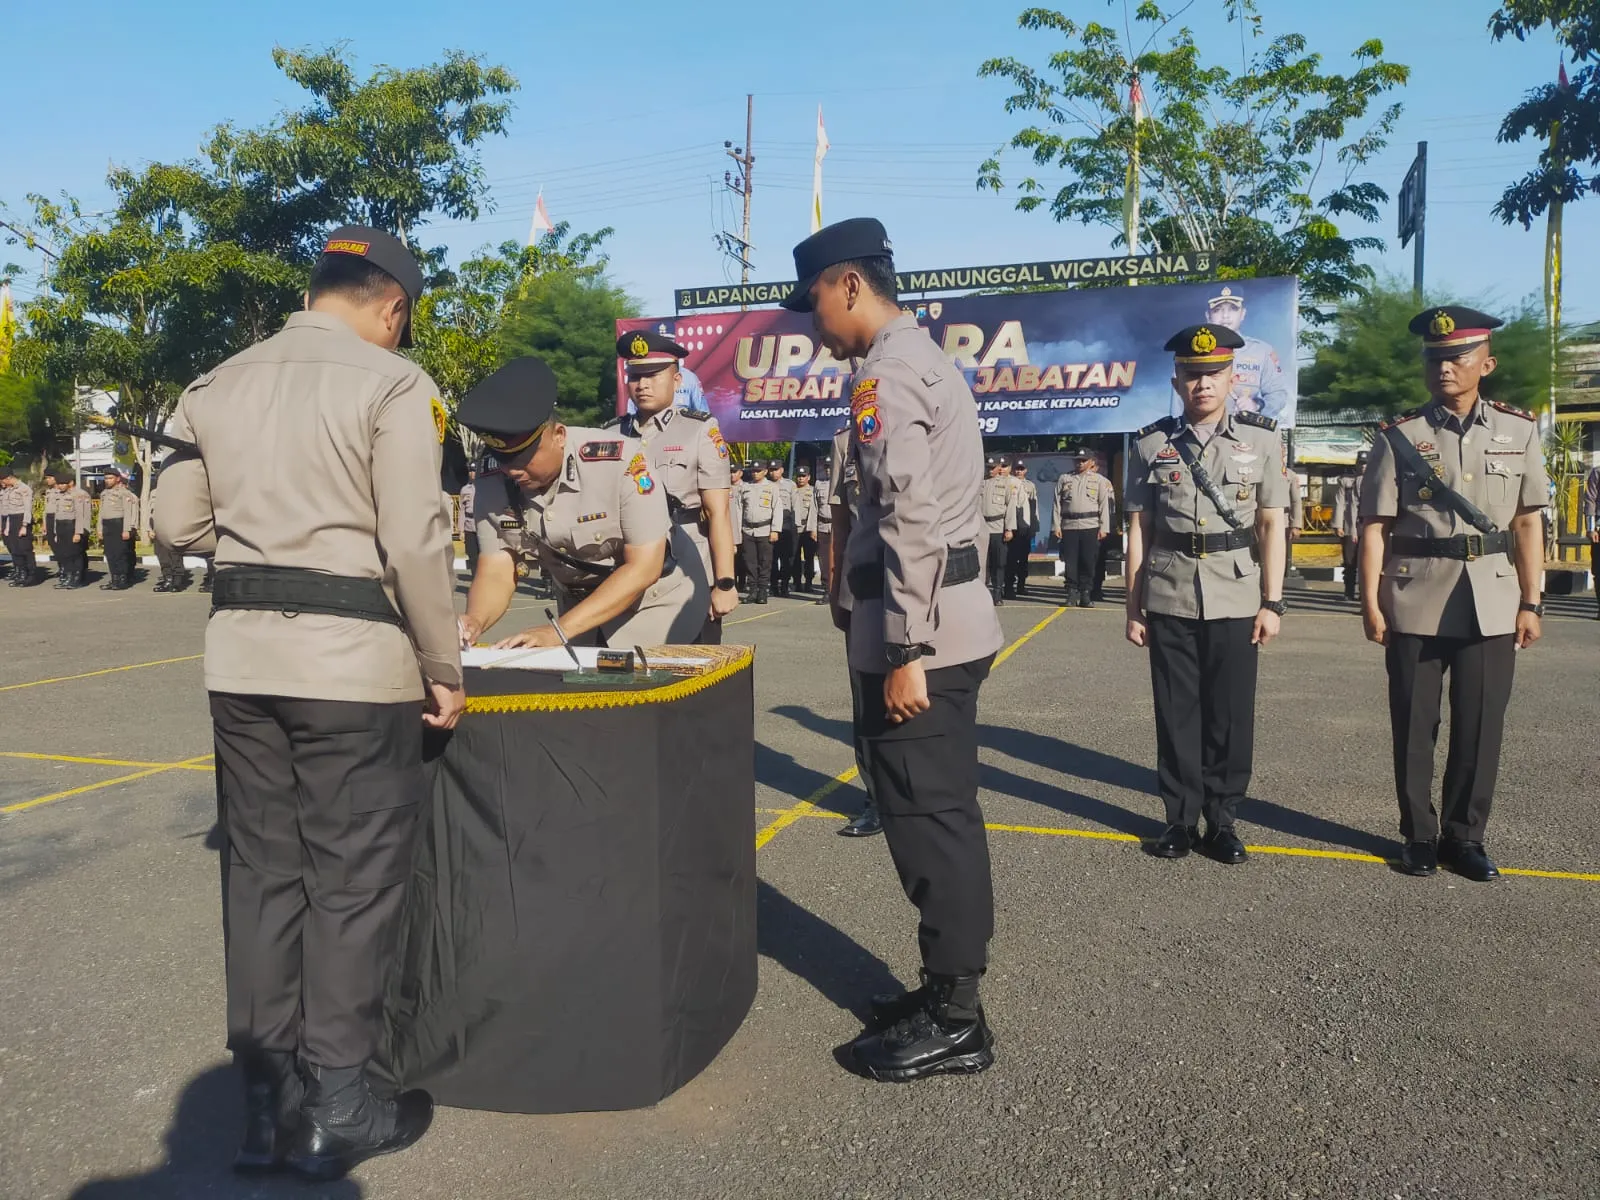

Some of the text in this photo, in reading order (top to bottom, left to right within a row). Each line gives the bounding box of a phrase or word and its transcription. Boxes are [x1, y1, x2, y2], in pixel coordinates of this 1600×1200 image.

[696, 284, 795, 305] LAPANGAN
[910, 264, 1045, 290] MANUNGGAL
[1050, 255, 1189, 280] WICAKSANA
[744, 375, 844, 402] SERAH
[972, 360, 1136, 393] JABATAN
[740, 408, 819, 419] KASATLANTAS,
[821, 407, 850, 417] KAPO
[984, 399, 1049, 411] KAPOLSEK
[1050, 397, 1120, 409] KETAPANG
